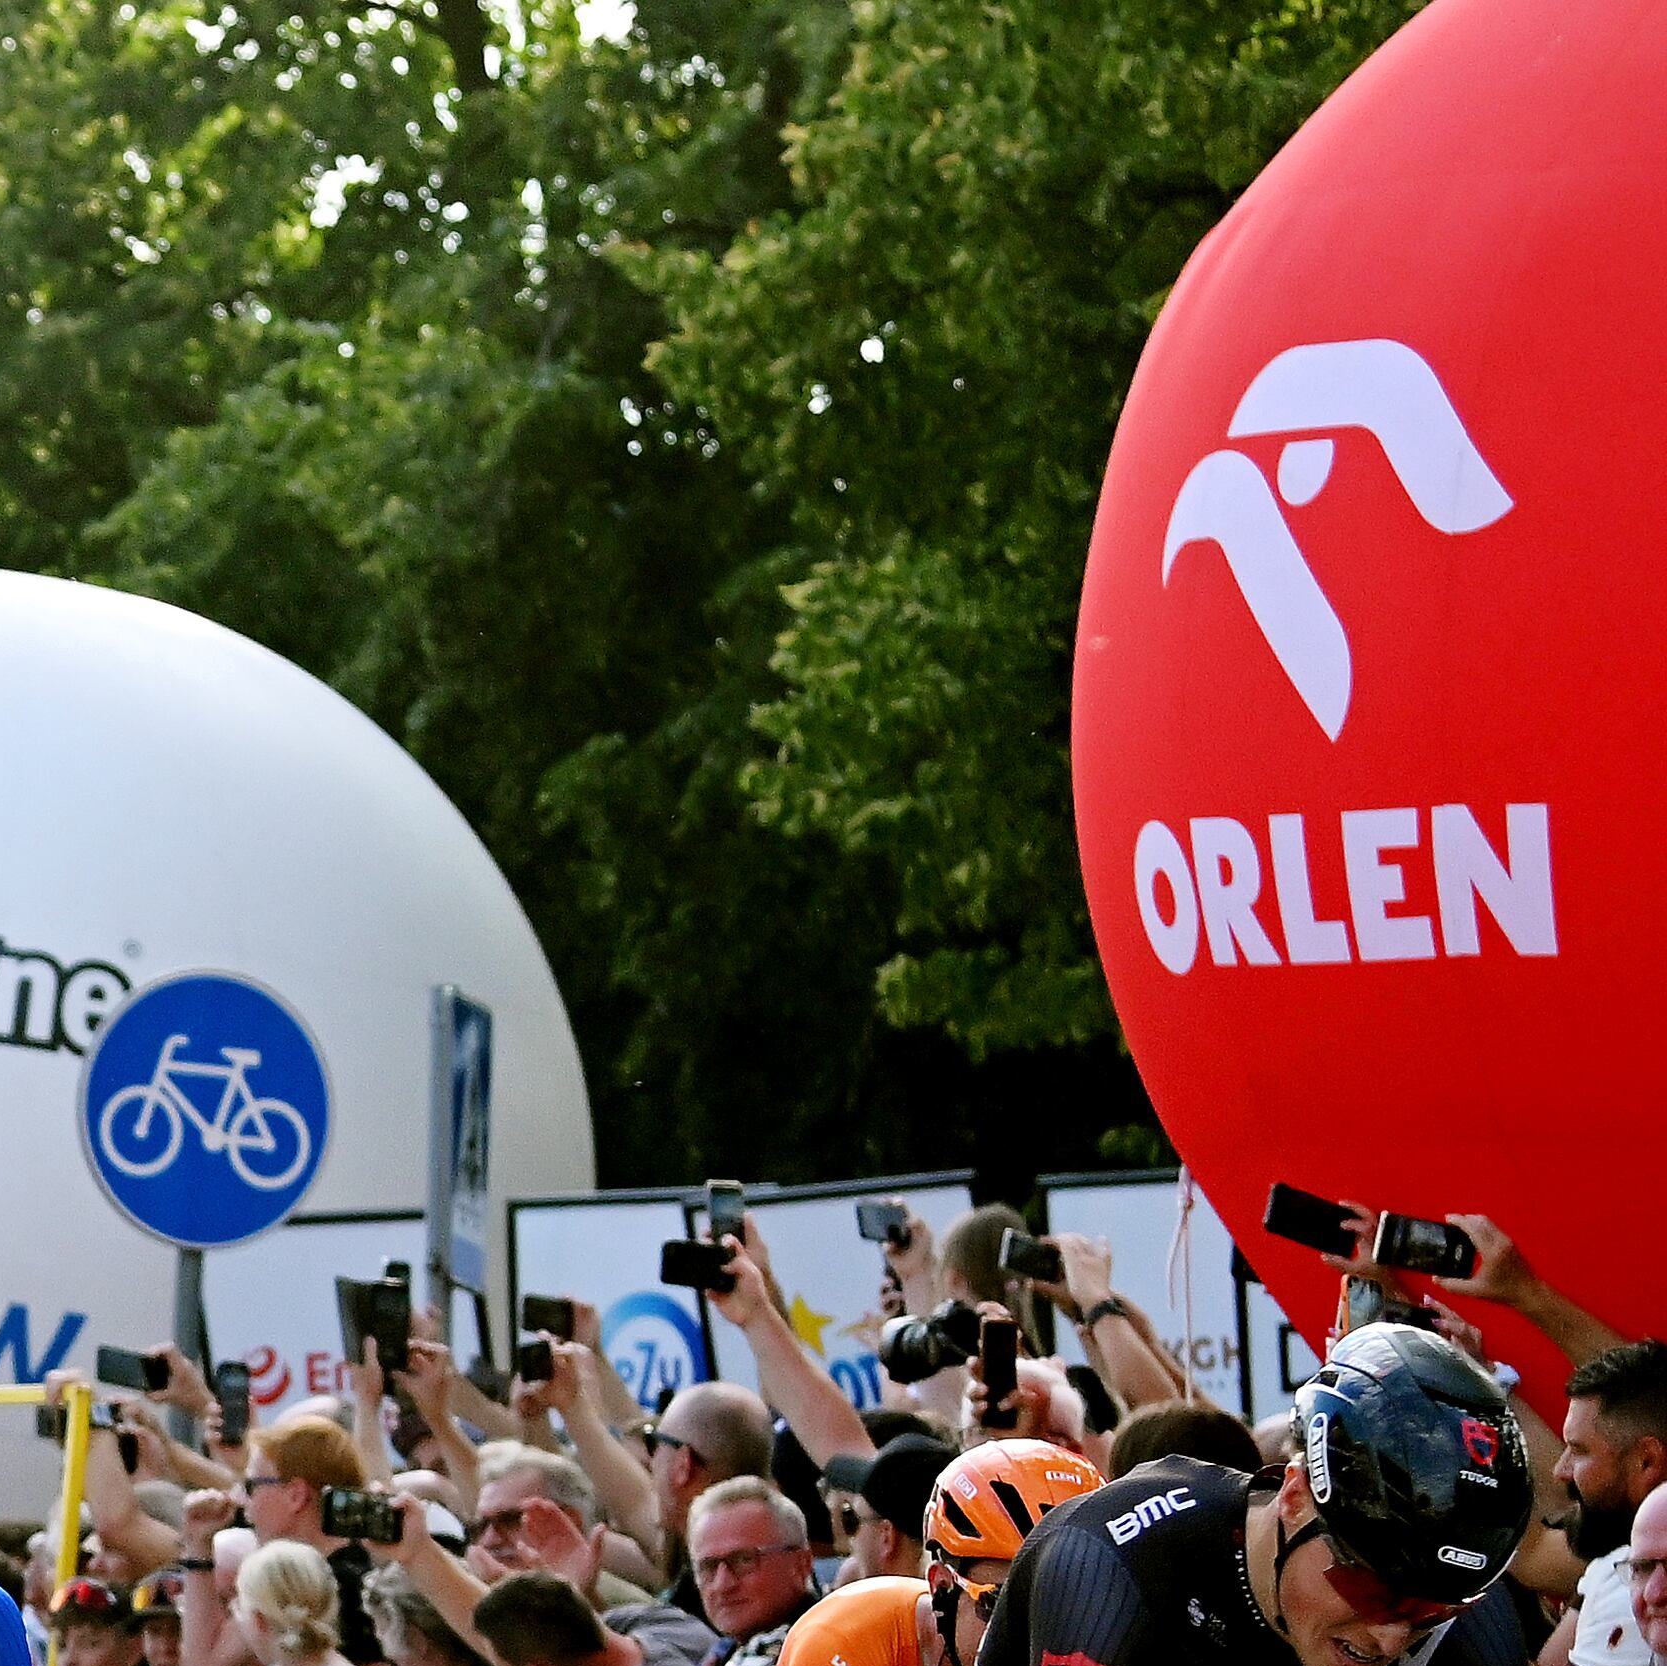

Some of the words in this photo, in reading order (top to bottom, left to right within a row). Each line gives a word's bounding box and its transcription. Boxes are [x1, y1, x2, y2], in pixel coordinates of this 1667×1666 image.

[1134, 803, 1559, 976] ORLEN
[1459, 1470, 1498, 1488] TUDOR
[1105, 1486, 1196, 1546] BMC
